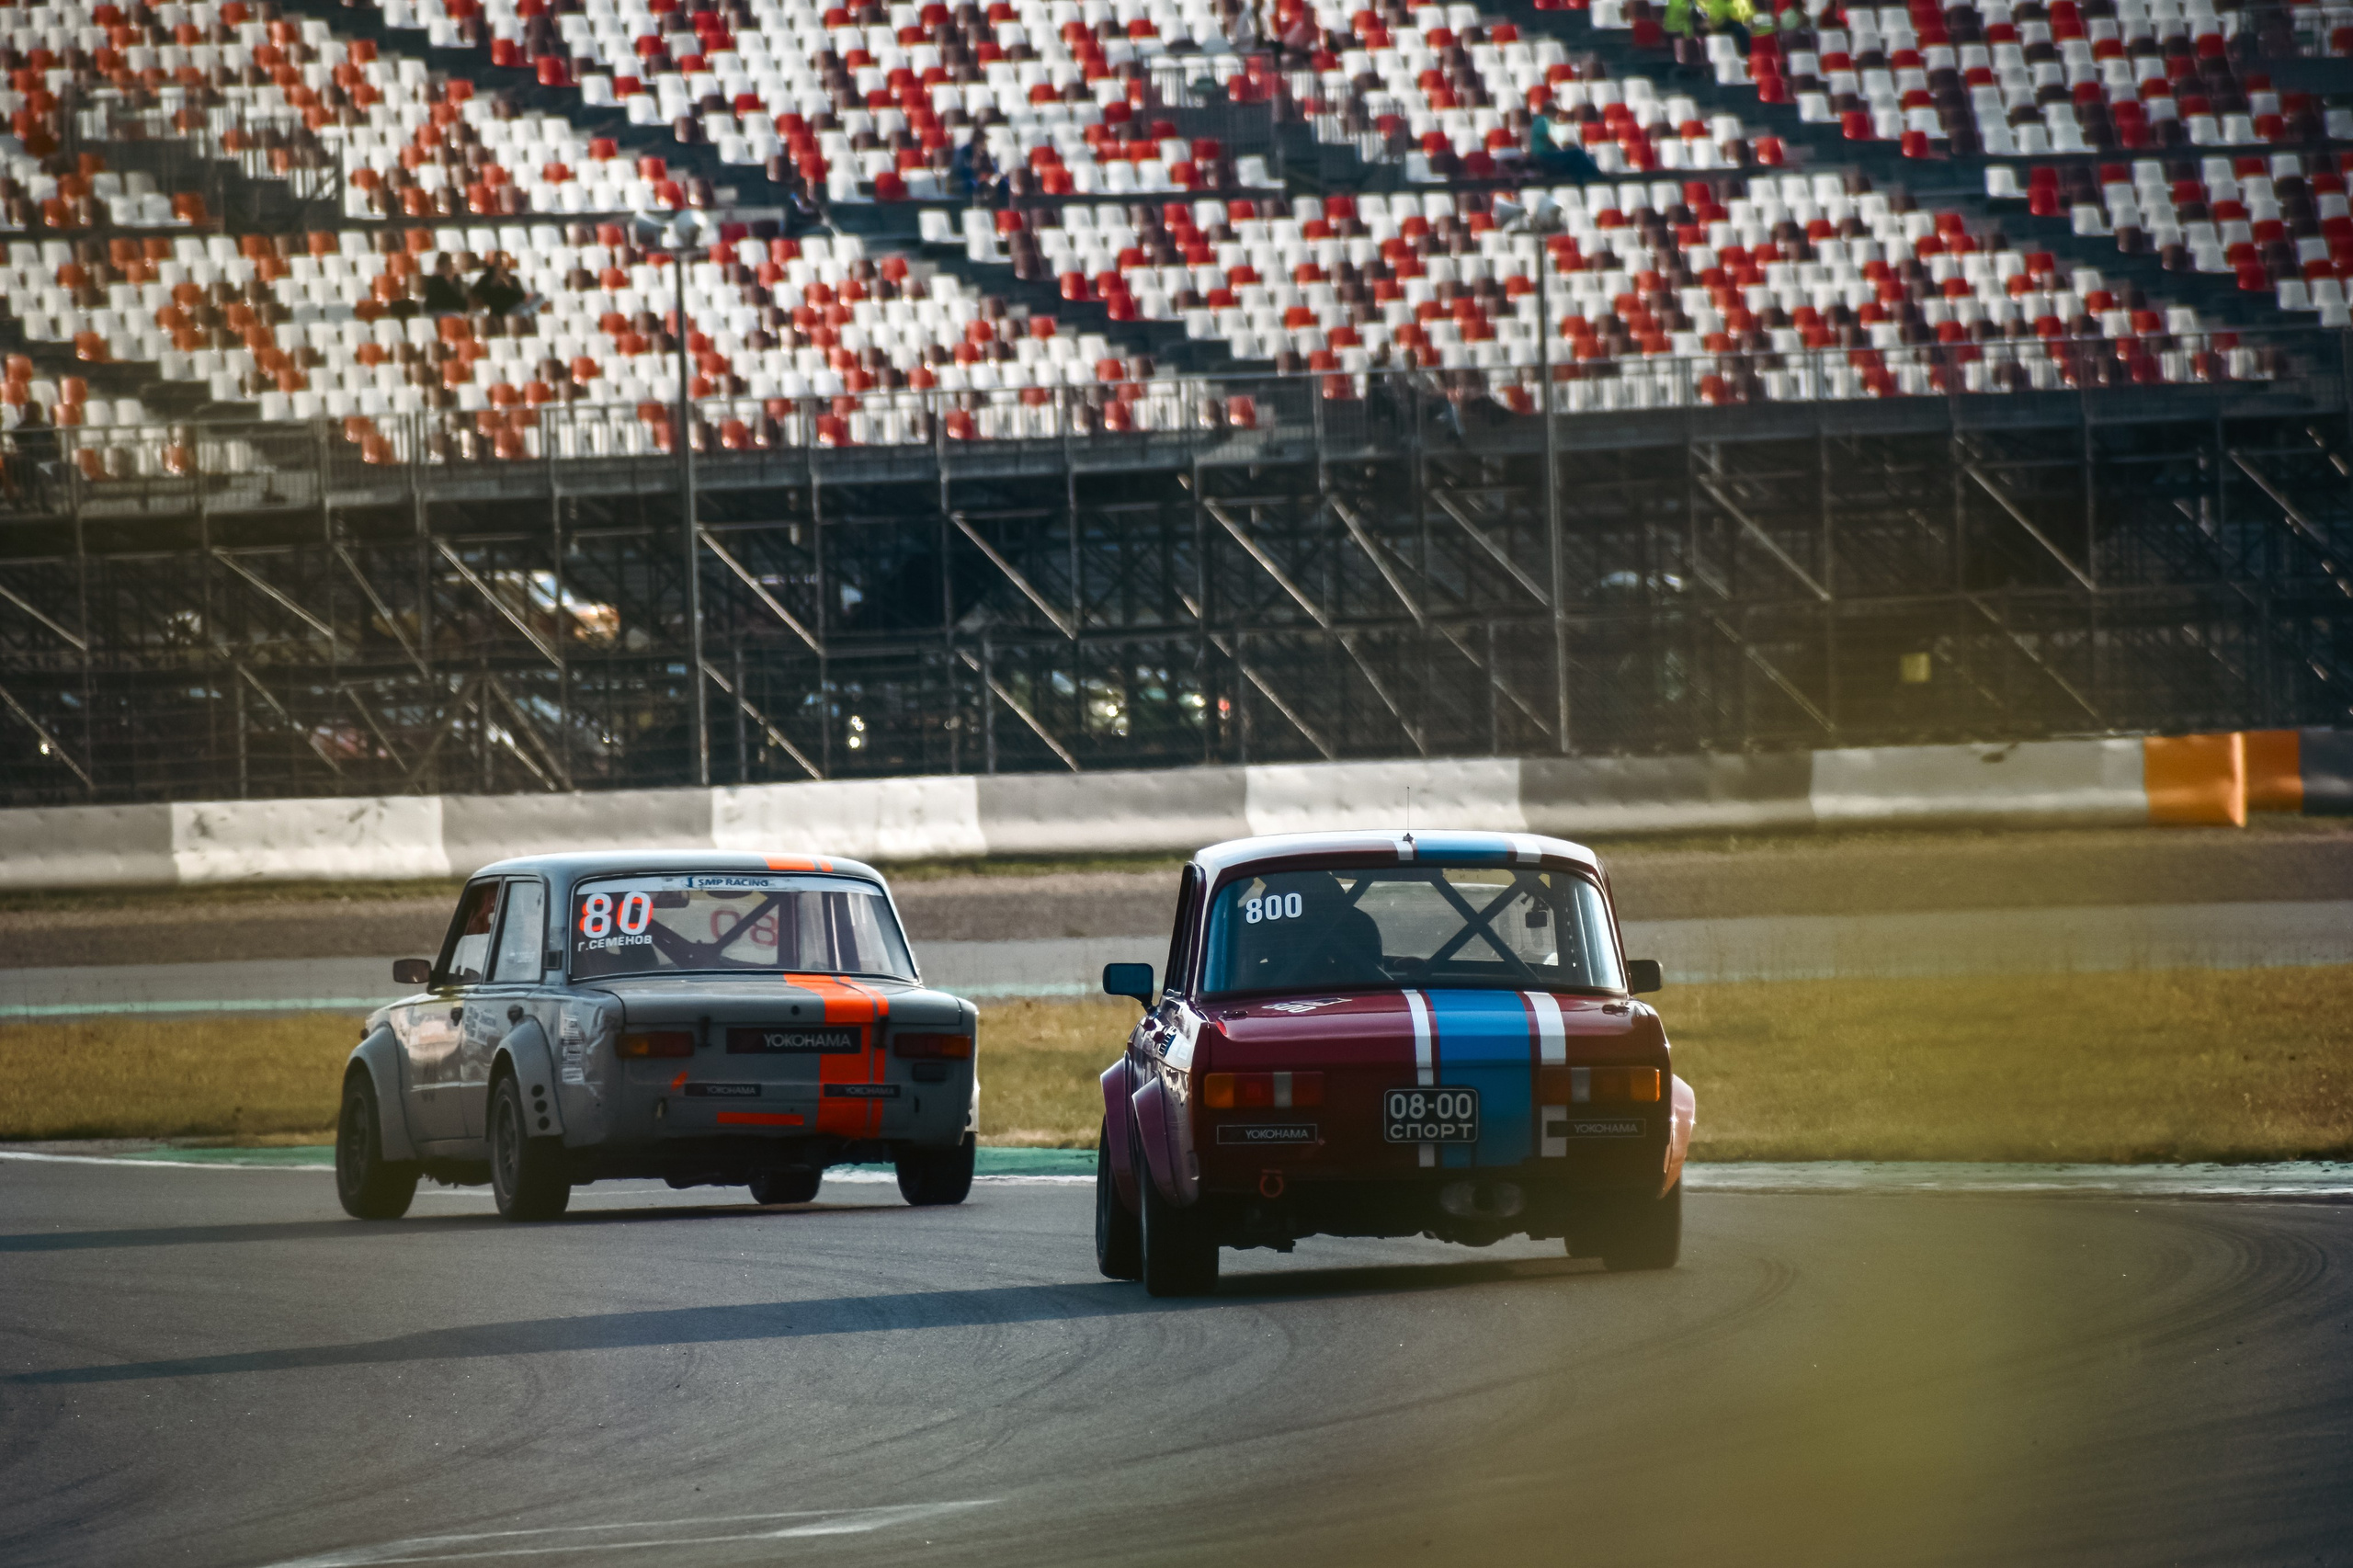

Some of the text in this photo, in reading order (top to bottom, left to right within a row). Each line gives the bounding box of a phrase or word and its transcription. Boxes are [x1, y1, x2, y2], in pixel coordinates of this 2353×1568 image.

[725, 879, 768, 887] RACING
[1245, 892, 1302, 924] 800
[579, 892, 654, 938] 80
[764, 1034, 851, 1048] YOKOHAMA
[706, 1085, 756, 1095] YOKOHAMA
[845, 1086, 894, 1096] YOKOHAMA
[1390, 1094, 1472, 1119] 08-00
[1245, 1129, 1309, 1139] YOKOHAMA
[1390, 1123, 1472, 1139] СПОРТ
[1574, 1123, 1638, 1133] YOKOHAMA
